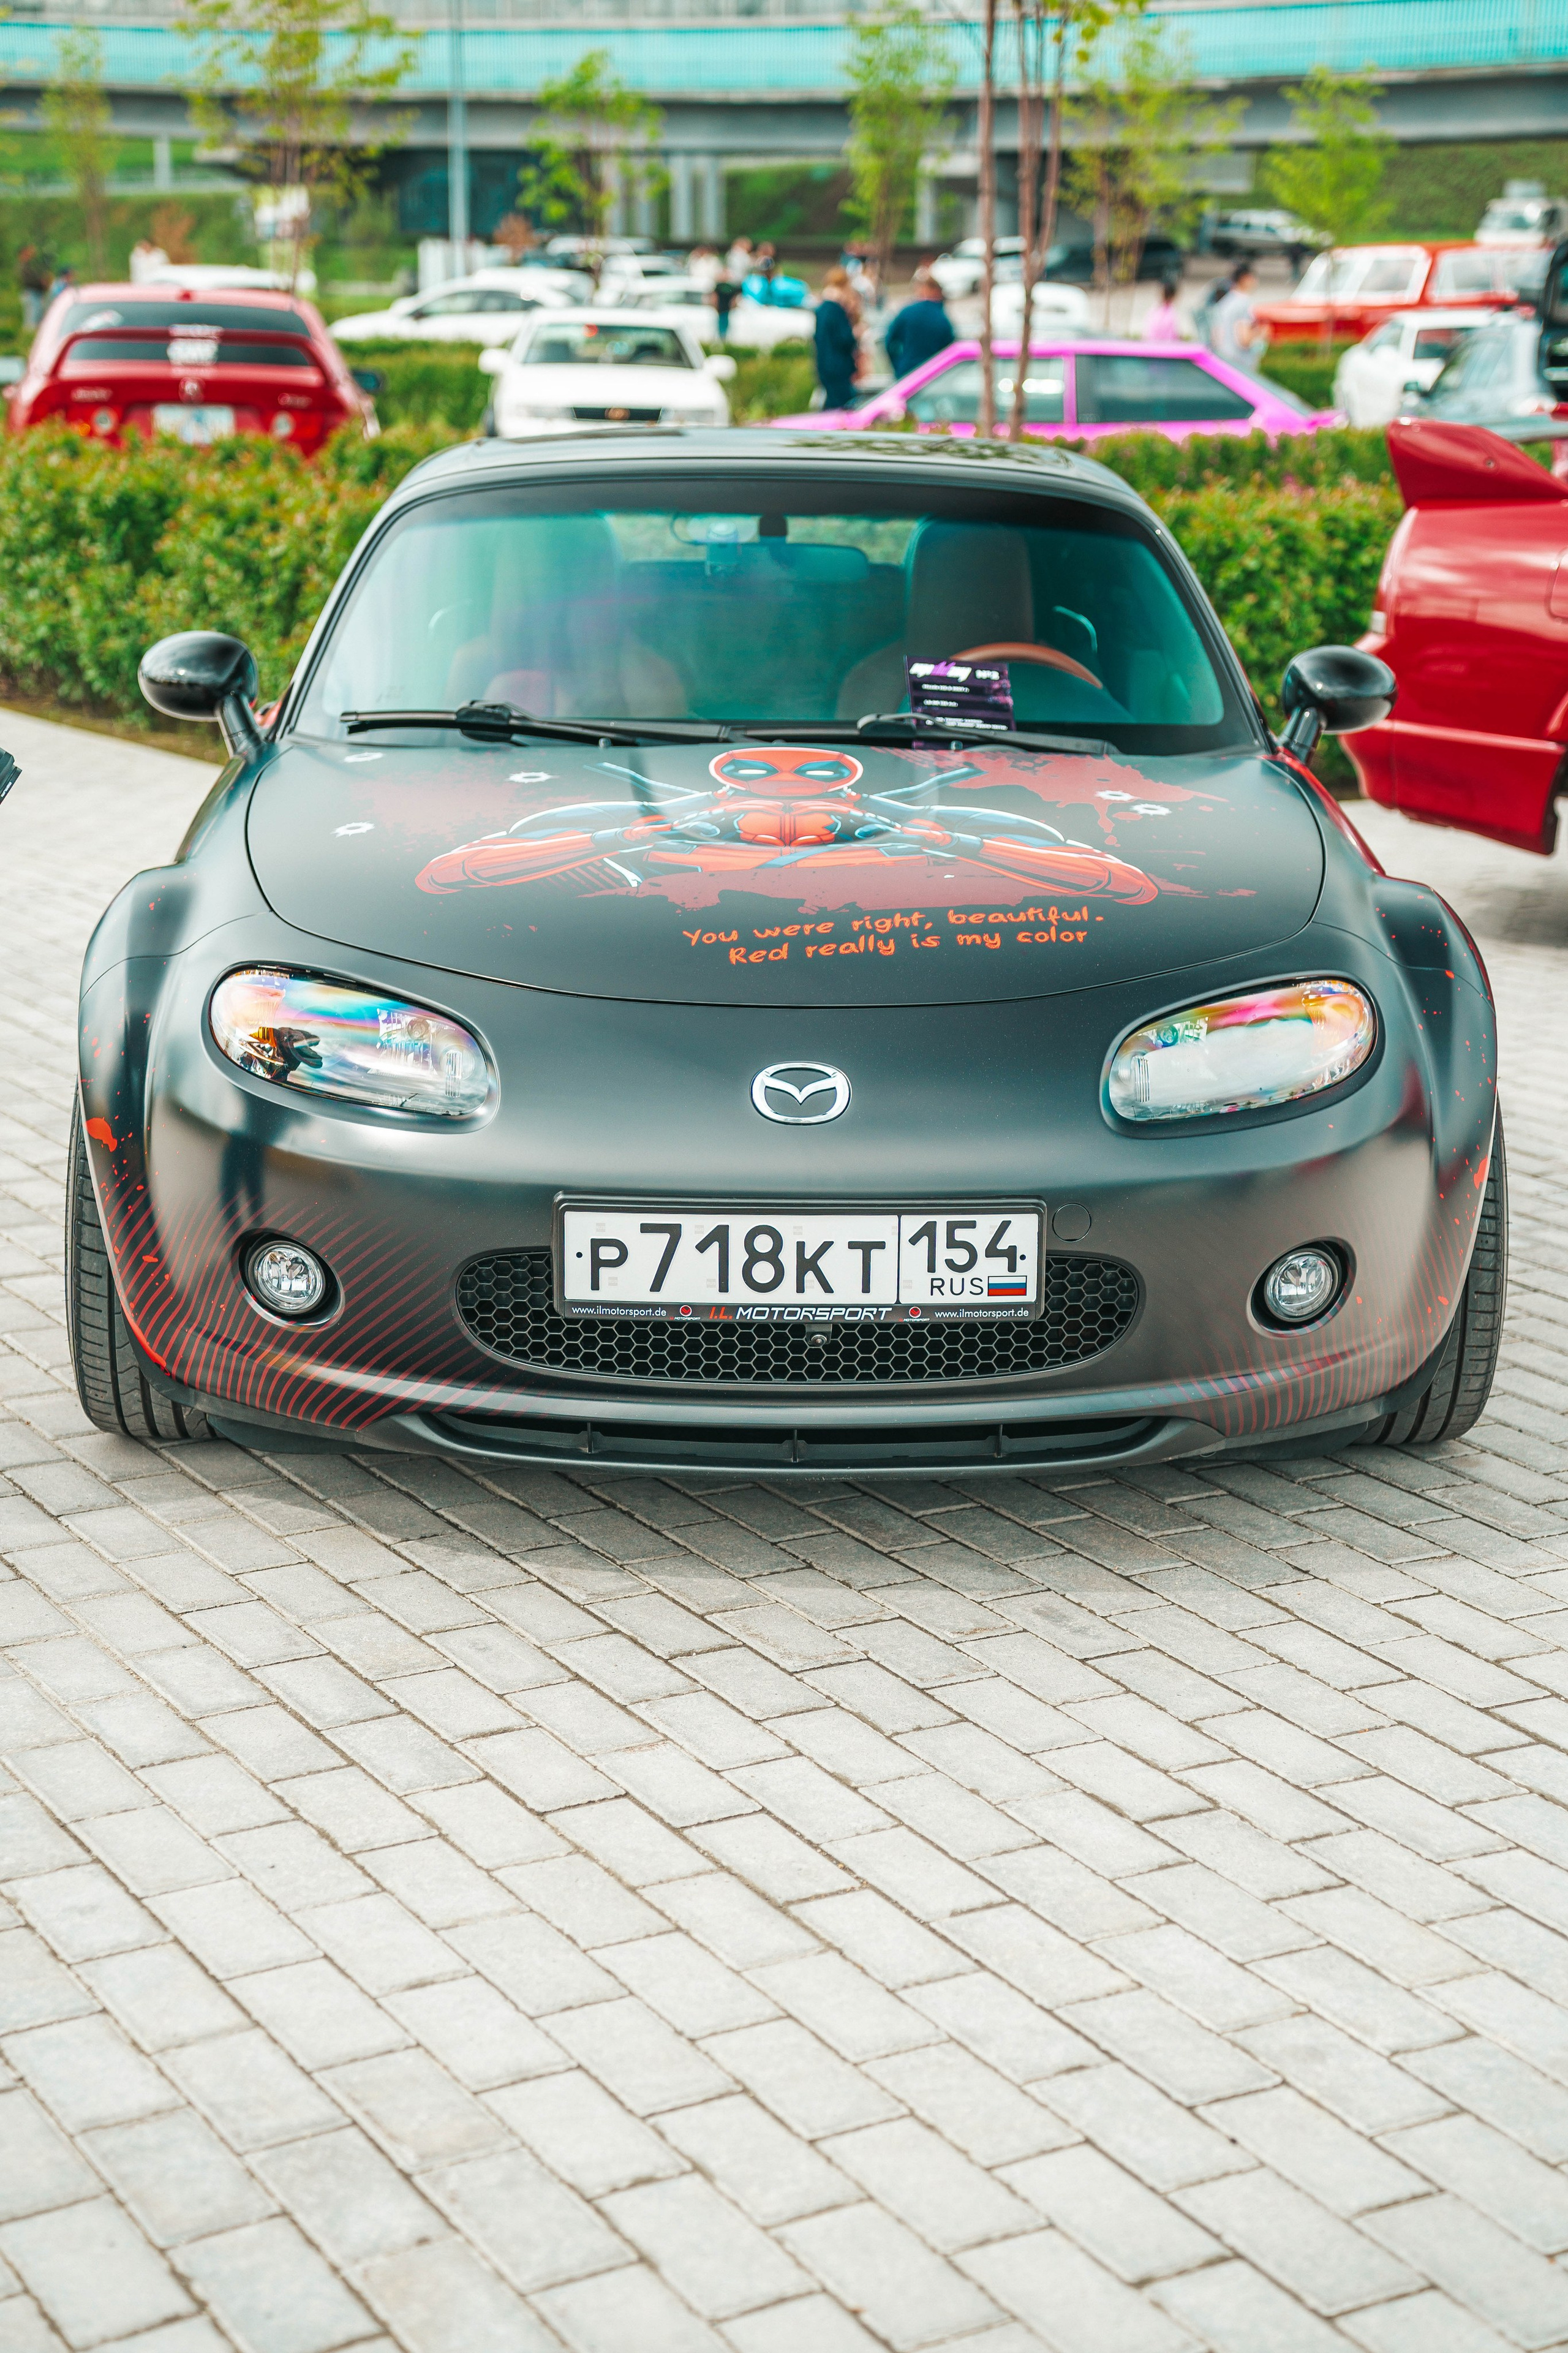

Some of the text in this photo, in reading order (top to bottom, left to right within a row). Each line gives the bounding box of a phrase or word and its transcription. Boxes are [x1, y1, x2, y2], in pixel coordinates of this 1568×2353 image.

[682, 905, 1104, 946] You were right, beautiful.
[729, 926, 1087, 965] Red really is my color
[909, 1220, 1017, 1274] 154
[930, 1277, 984, 1296] RUS
[572, 1305, 666, 1318] www.ilmotorsport.de
[736, 1307, 892, 1320] MOTORSPORT
[935, 1307, 1029, 1319] www.ilmotorsport.de
